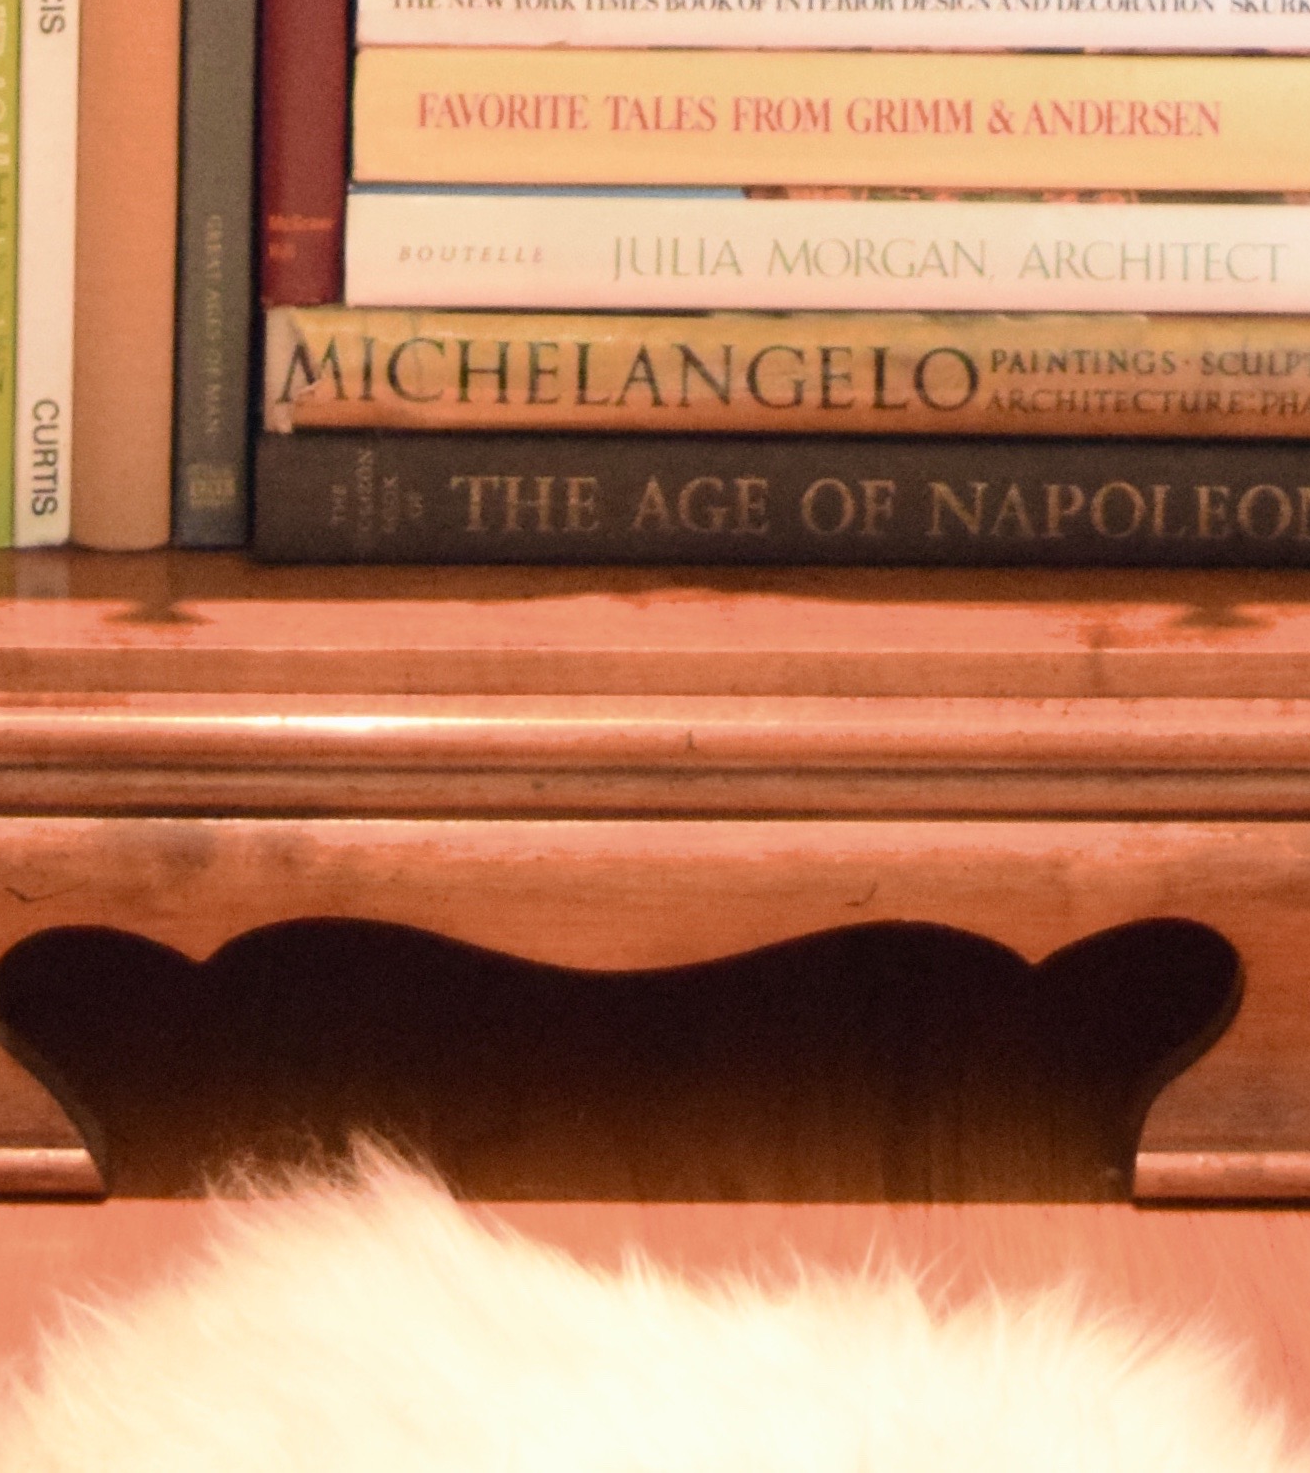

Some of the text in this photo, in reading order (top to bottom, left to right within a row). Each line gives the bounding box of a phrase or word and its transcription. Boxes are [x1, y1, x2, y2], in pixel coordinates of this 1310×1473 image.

[417, 92, 1224, 138] FAVORITE TALES FROM GRIMM & ANDERSEN
[397, 245, 544, 264] BOUTELLE
[613, 237, 744, 281] JULIA
[1016, 239, 1288, 283] ARCHITECT
[275, 337, 979, 412] MICHELANGELO
[991, 349, 1177, 375] PAINTINGS
[32, 399, 60, 517] CURTIS
[451, 476, 600, 533] THE
[632, 475, 770, 535] AGE
[801, 477, 895, 537] OF
